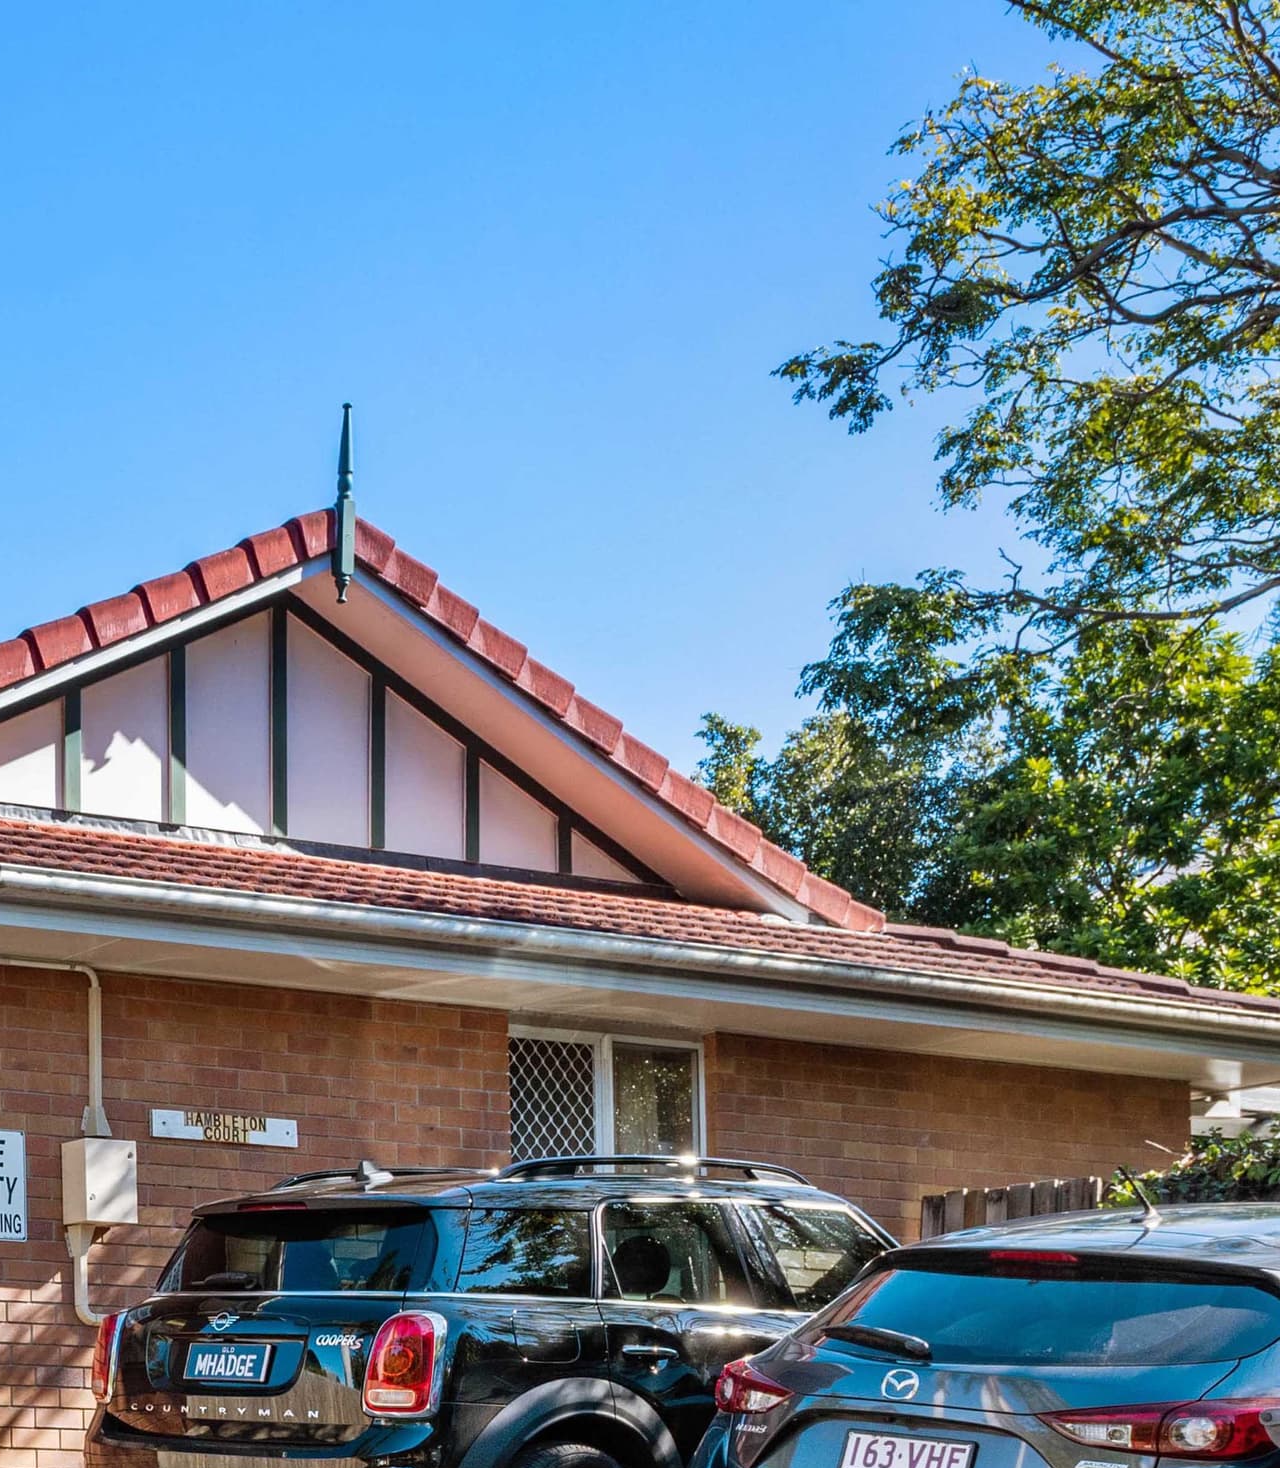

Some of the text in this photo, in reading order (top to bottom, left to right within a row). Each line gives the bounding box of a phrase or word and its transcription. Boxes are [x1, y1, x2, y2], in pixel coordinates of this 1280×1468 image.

[184, 1112, 267, 1132] HAMBLETON
[203, 1126, 250, 1143] COURT
[316, 1334, 357, 1346] COOPER
[194, 1353, 258, 1377] MHADGE
[130, 1402, 320, 1419] COUNTRYMAN
